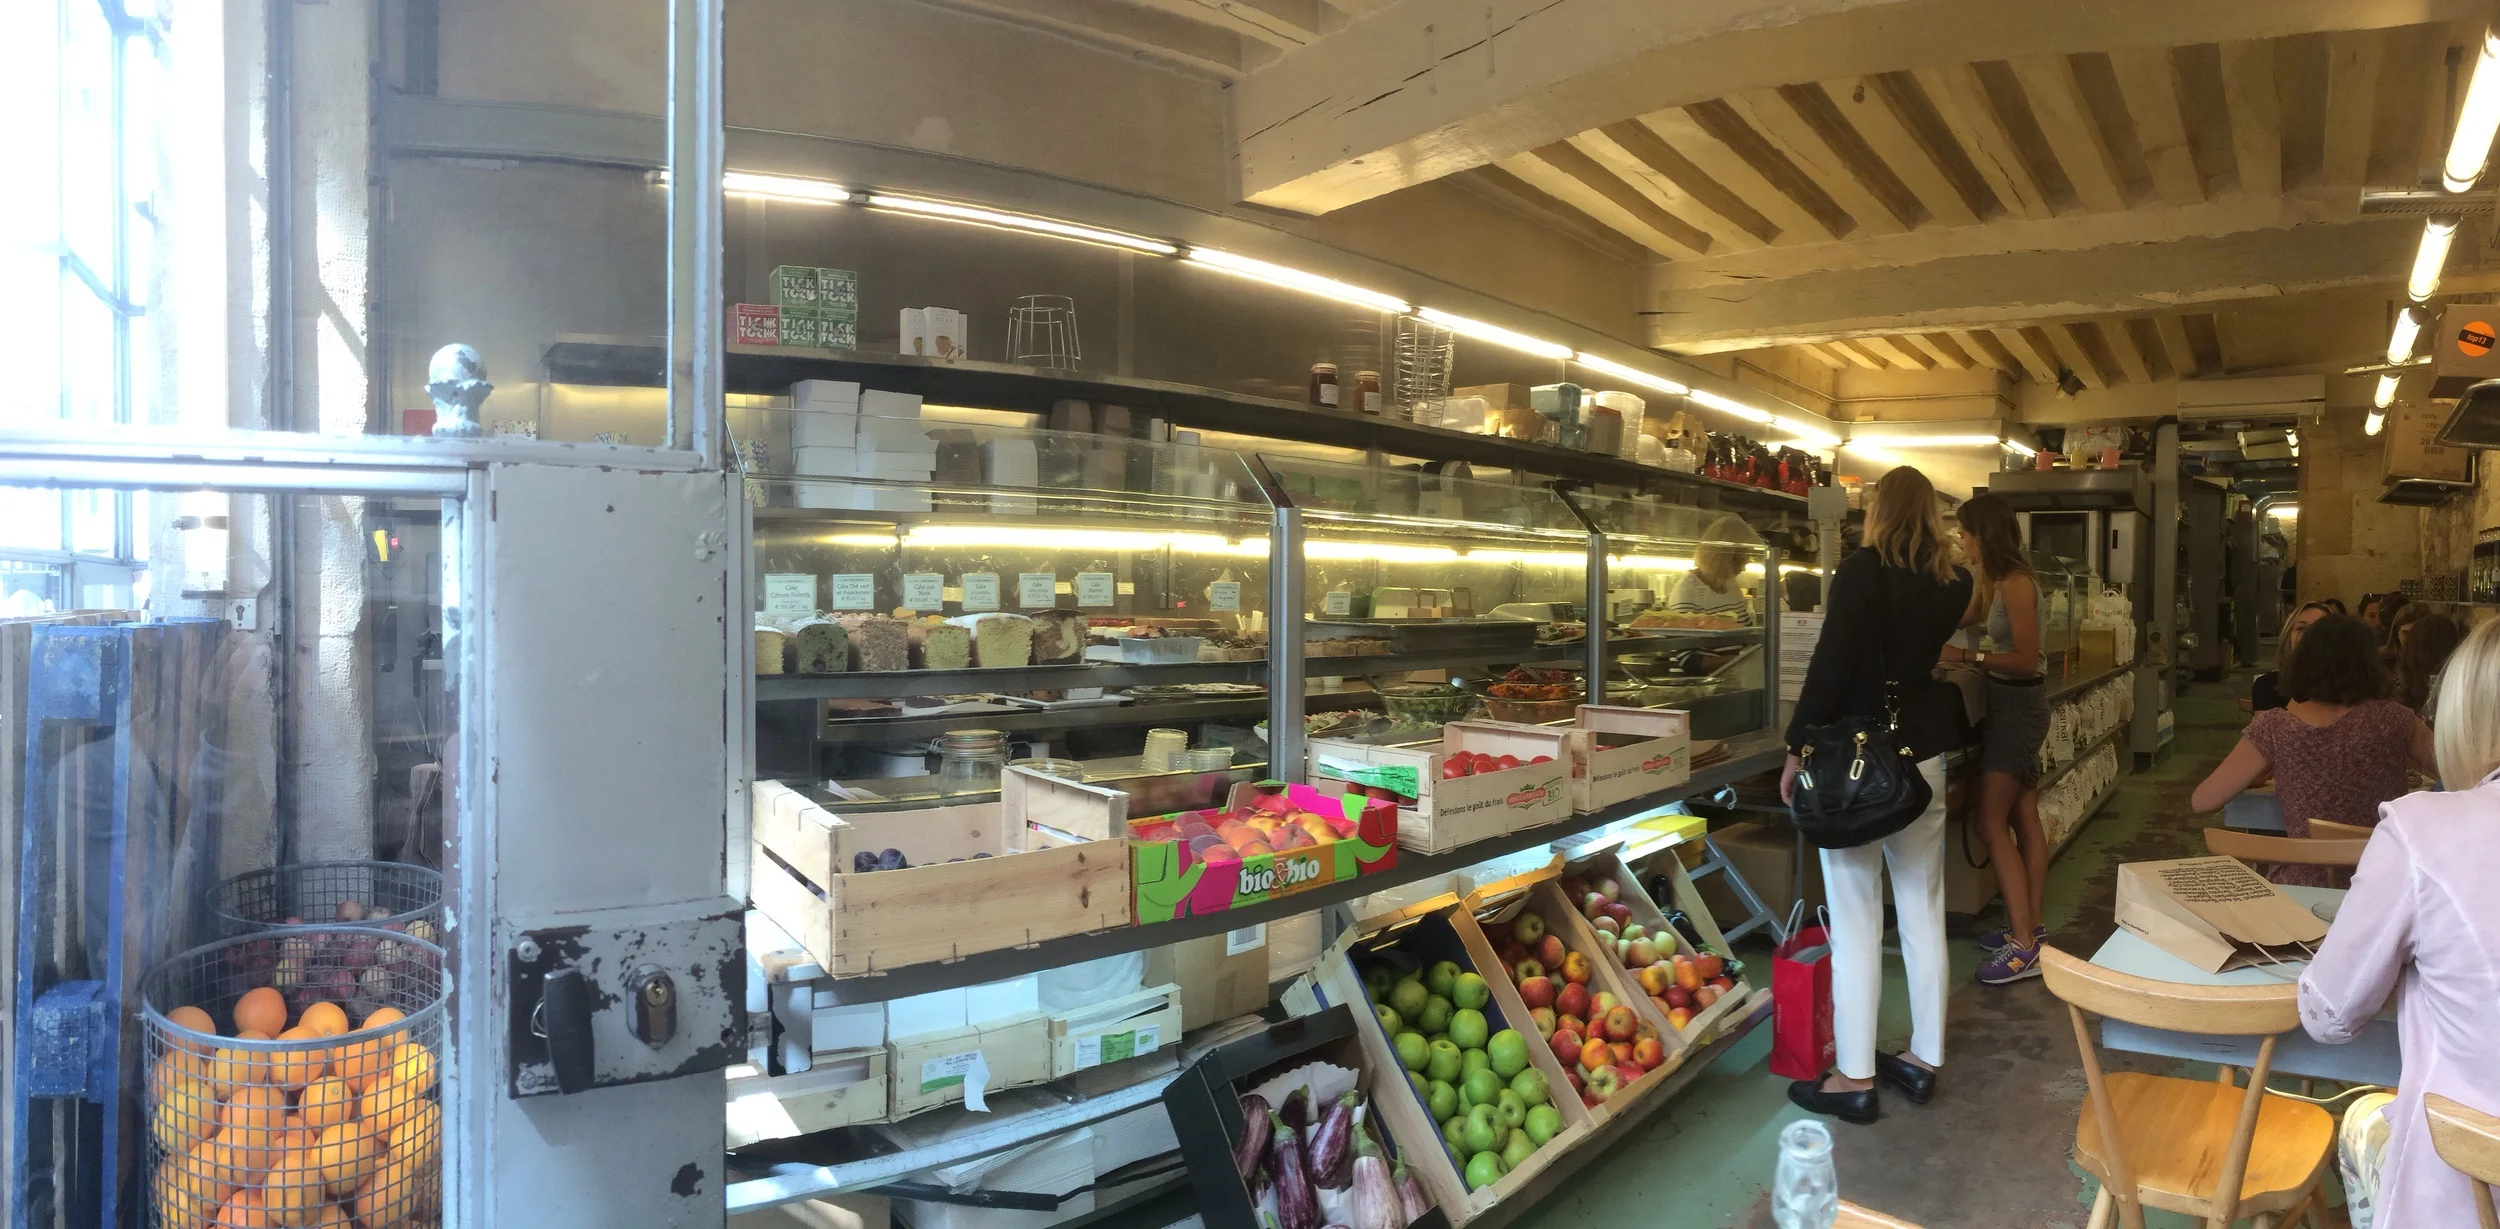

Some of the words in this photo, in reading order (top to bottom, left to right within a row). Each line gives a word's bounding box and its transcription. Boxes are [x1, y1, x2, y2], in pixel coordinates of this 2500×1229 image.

[782, 276, 814, 288] TICK
[821, 279, 855, 292] TICK
[782, 288, 816, 301] TOCK
[820, 290, 855, 303] TOCK
[782, 318, 814, 330] TICK
[820, 321, 854, 333] TICK
[781, 329, 815, 342] TOCK
[820, 332, 855, 345] TOCK
[2467, 333, 2487, 345] top13
[2101, 609, 2123, 617] markal
[1547, 787, 1560, 802] BIO
[1440, 805, 1466, 817] Défendons
[1467, 804, 1472, 812] le
[1472, 801, 1484, 813] goût
[1484, 799, 1491, 807] du
[1492, 798, 1504, 806] frais
[1239, 864, 1273, 895] bio
[1287, 856, 1320, 884] bio
